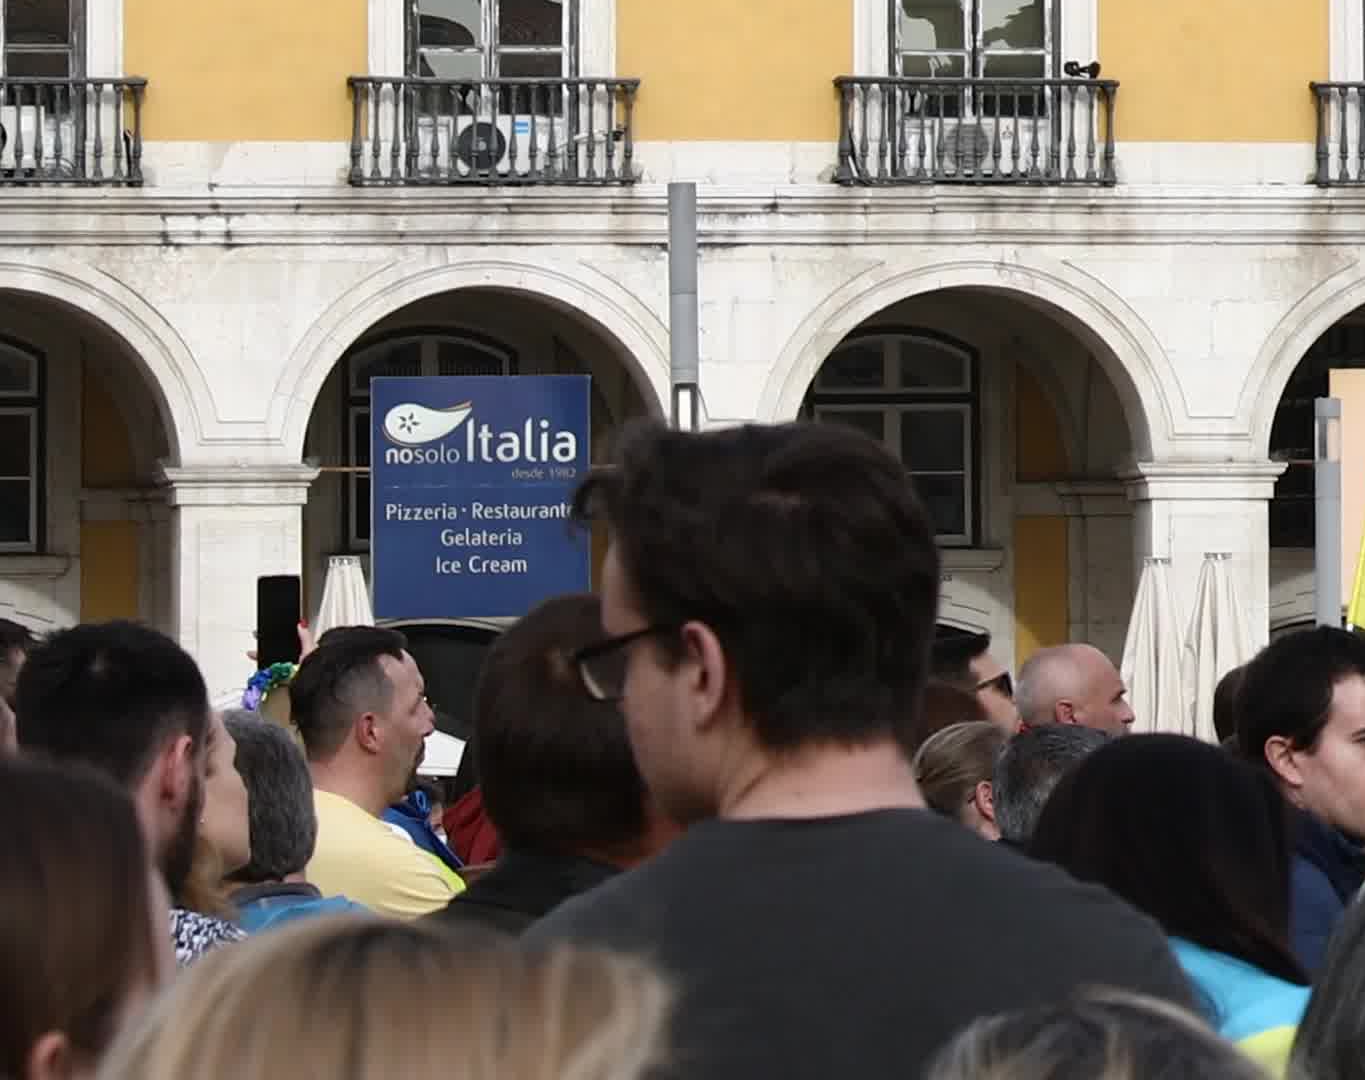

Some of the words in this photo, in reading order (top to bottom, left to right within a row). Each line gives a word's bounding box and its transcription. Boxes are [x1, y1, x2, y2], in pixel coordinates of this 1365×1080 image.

[385, 444, 461, 465] nosolo
[466, 417, 577, 463] Italia
[385, 503, 458, 521] Pizzeria
[440, 528, 523, 546] Gelateria
[436, 556, 461, 574] Ice
[468, 556, 528, 574] Cream
